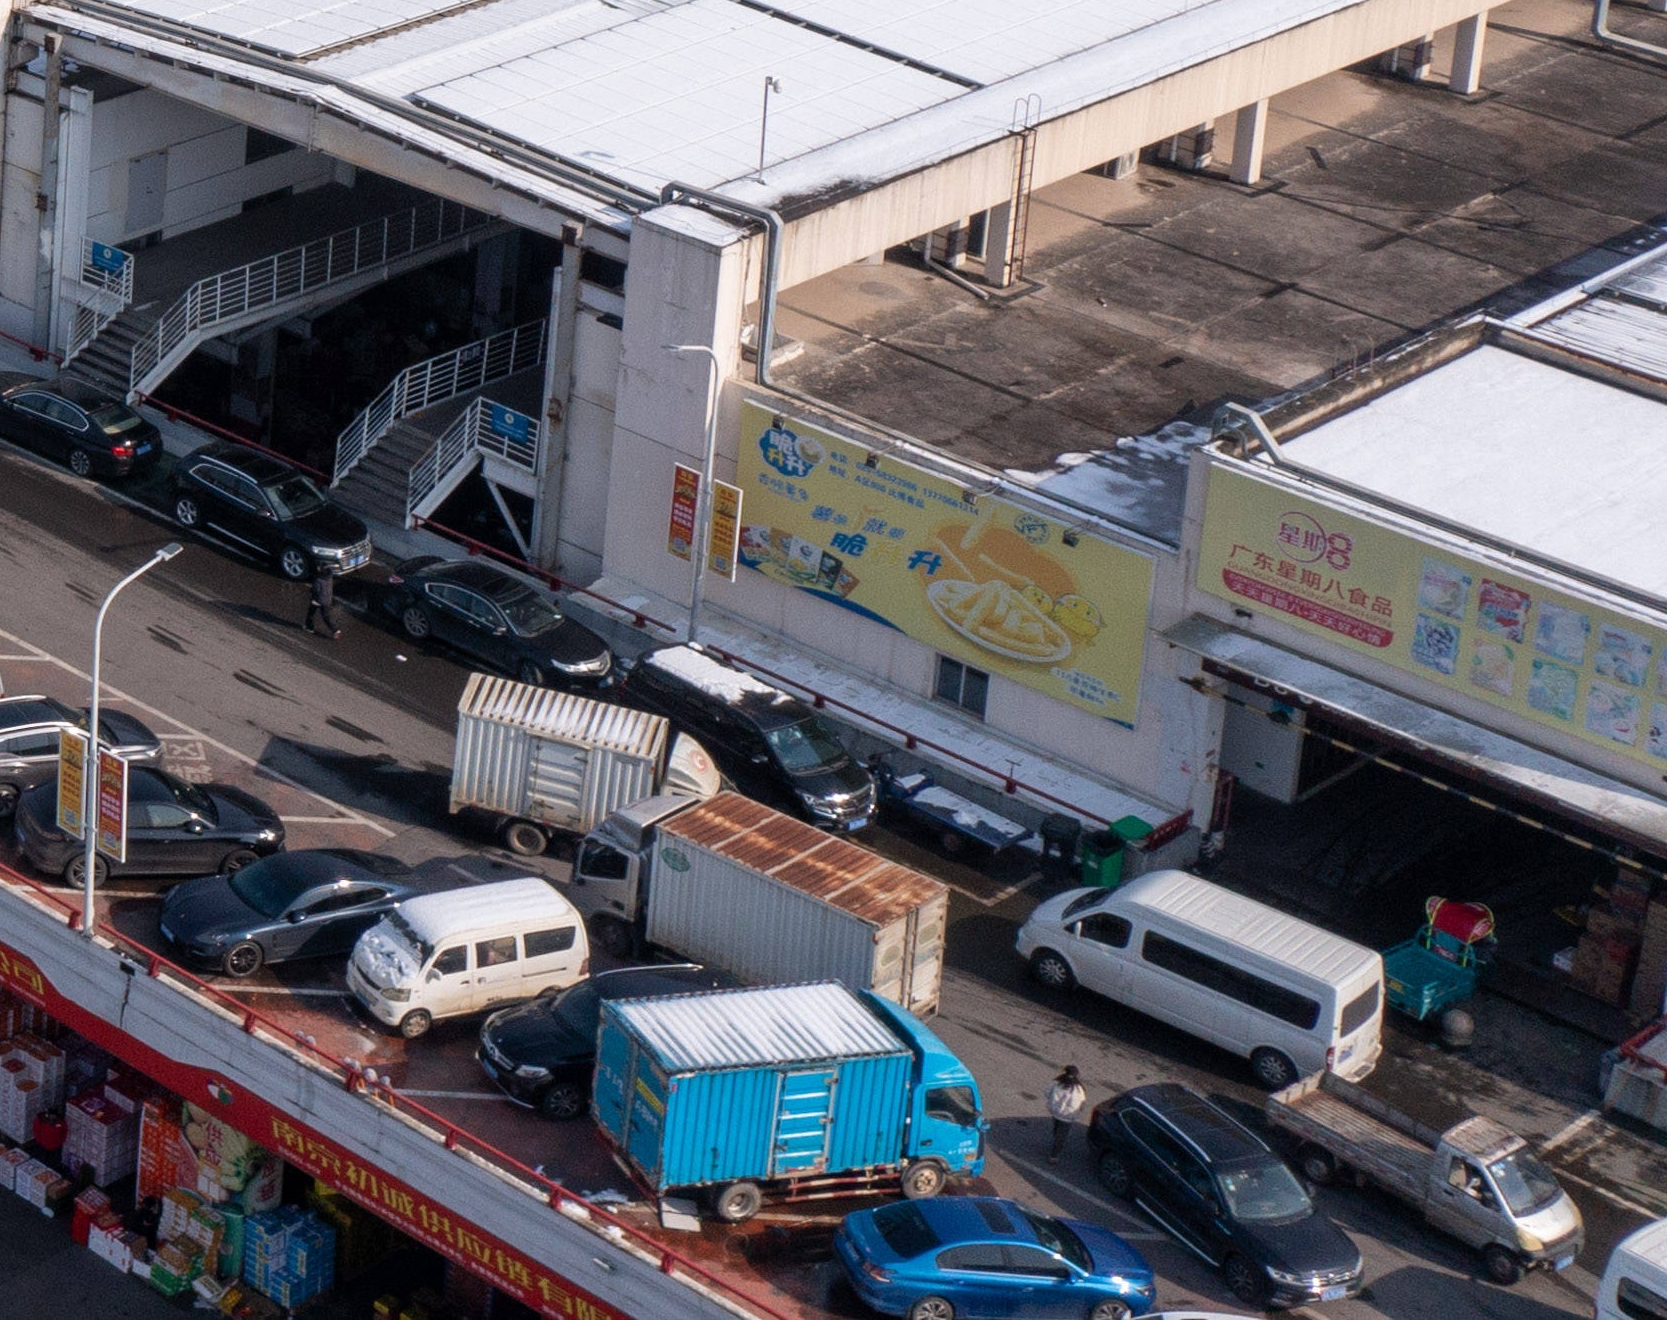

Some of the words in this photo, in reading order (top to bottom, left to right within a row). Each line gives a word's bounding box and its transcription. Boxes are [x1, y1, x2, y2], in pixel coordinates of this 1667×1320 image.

[1229, 543, 1393, 618] 广东星期八食品
